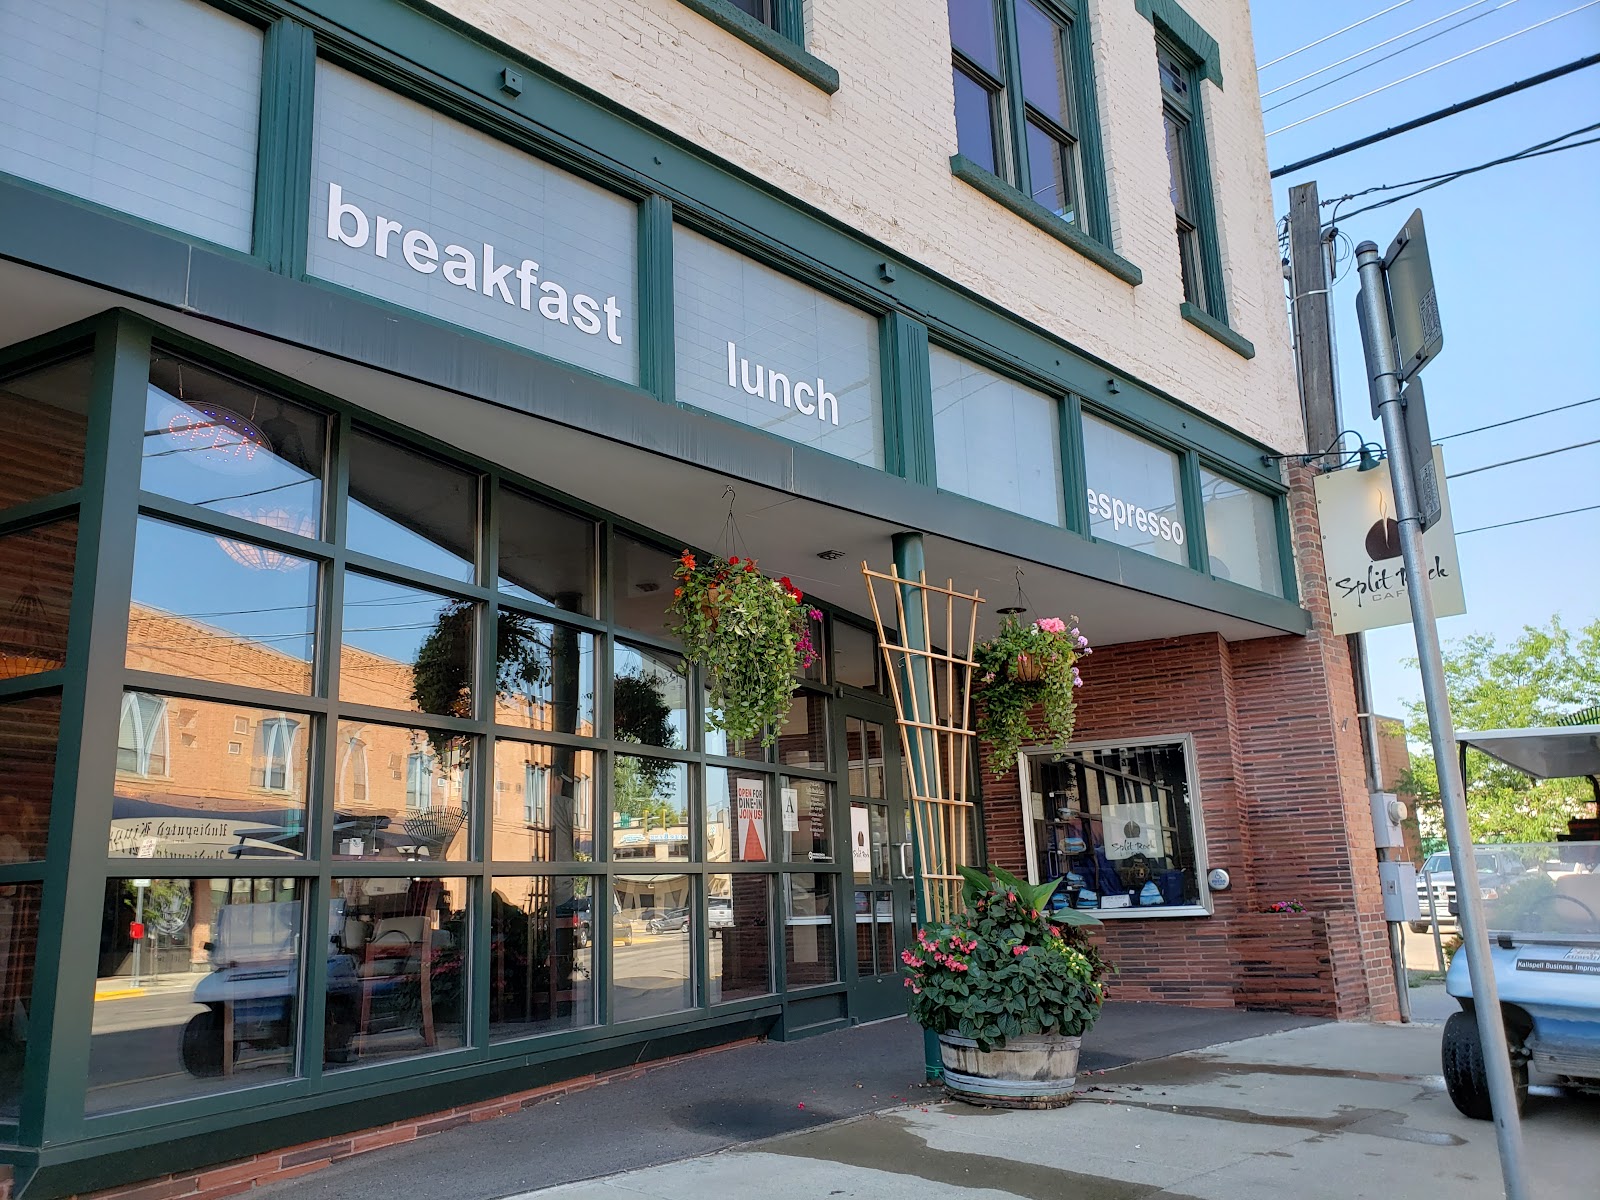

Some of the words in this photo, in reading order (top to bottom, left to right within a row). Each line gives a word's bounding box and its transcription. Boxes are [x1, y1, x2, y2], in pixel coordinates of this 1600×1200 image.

[327, 182, 622, 345] breakfast
[727, 341, 839, 426] lunch
[168, 414, 262, 461] OPEN
[1087, 488, 1184, 545] espresso
[1335, 565, 1392, 608] Split
[1372, 590, 1405, 602] CAF
[739, 788, 752, 798] OPEN
[753, 789, 763, 799] FOR
[739, 798, 763, 810] DINE-IN
[786, 796, 794, 814] A
[739, 809, 752, 820] JOIN
[753, 809, 763, 820] US!
[1111, 839, 1133, 857] Split
[1134, 839, 1157, 850] Rock
[1517, 961, 1544, 969] Kalispell
[1545, 962, 1573, 971] Business
